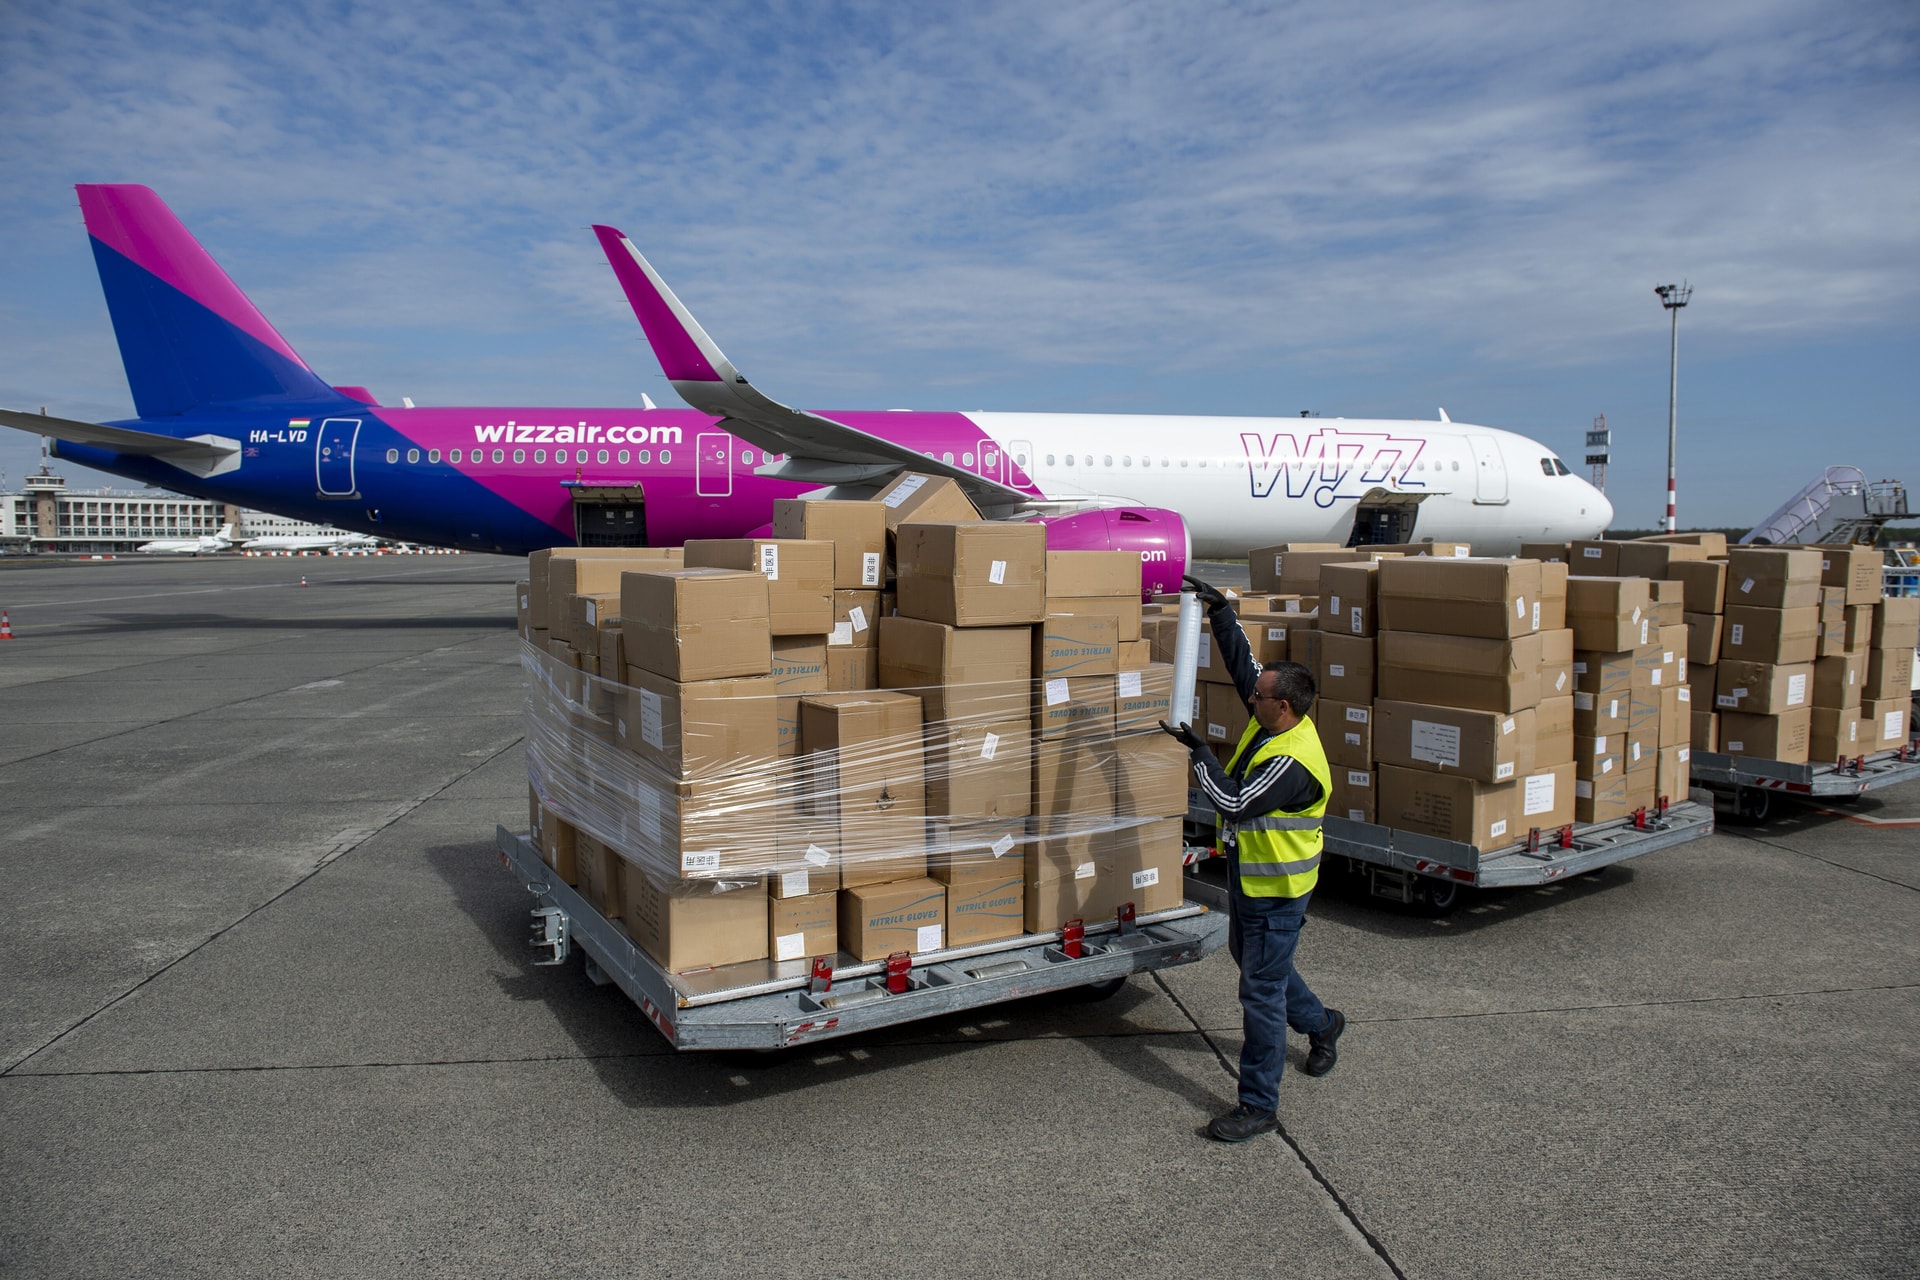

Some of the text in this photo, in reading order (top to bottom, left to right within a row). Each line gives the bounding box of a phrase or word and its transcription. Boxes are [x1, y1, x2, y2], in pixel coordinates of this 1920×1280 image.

[249, 430, 308, 443] HA-LVD
[474, 421, 683, 444] wizzair.com
[866, 556, 876, 583] 非医用
[1050, 647, 1112, 657] NITRILE GLOVES
[786, 665, 821, 675] NITRILE
[1123, 700, 1150, 710] GLOVES
[1049, 706, 1110, 718] NITRILE GLOVES
[686, 855, 715, 866] 非医用
[955, 896, 1017, 913] NITRILE GLOVES
[869, 910, 939, 928] NITRILE GLOVES
